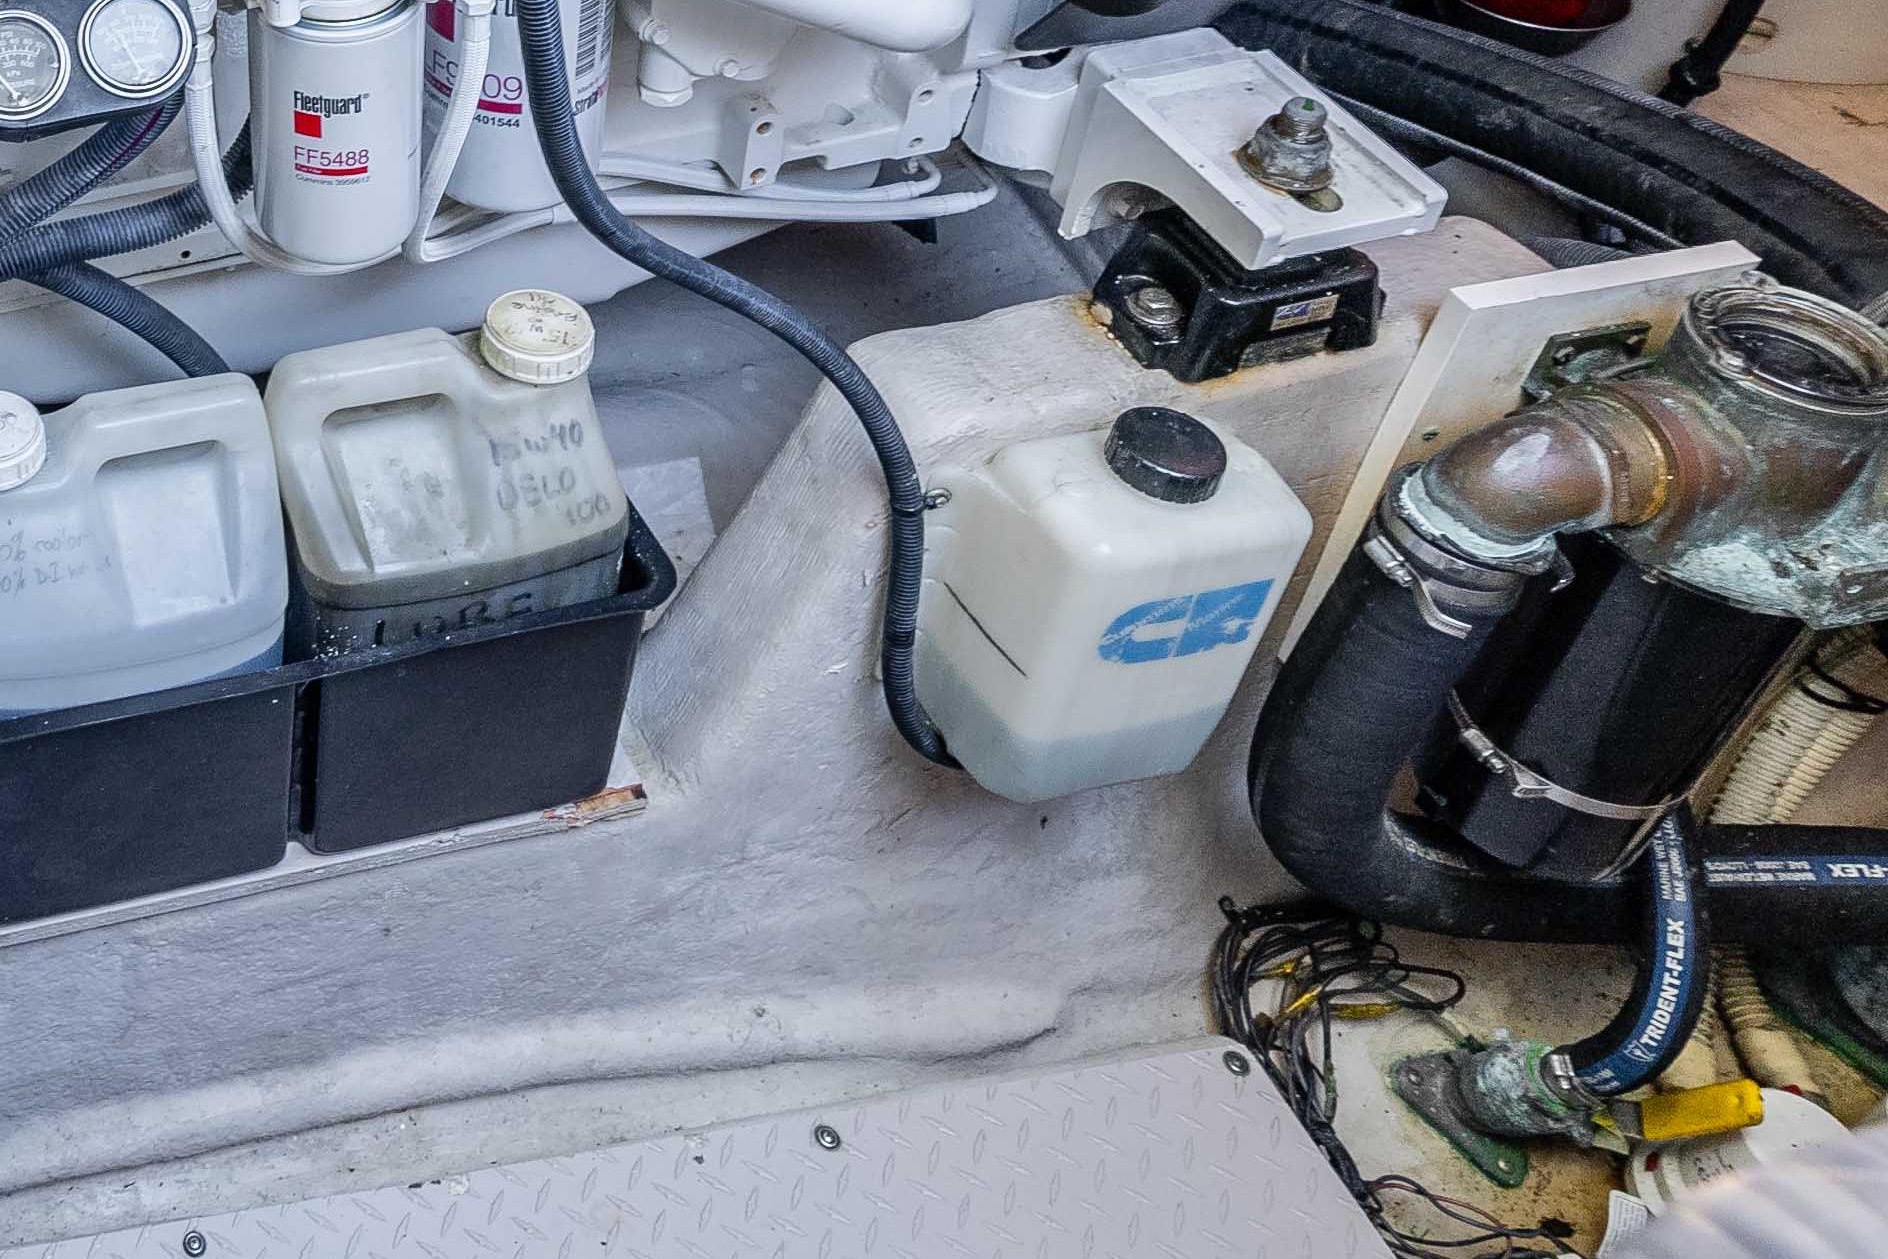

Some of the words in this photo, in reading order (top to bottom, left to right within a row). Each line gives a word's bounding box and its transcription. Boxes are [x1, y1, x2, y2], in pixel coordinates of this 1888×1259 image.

[293, 89, 363, 119] Fleetguard
[293, 144, 370, 168] FF5488
[1641, 918, 1686, 1047] TRIDENT-FLEX
